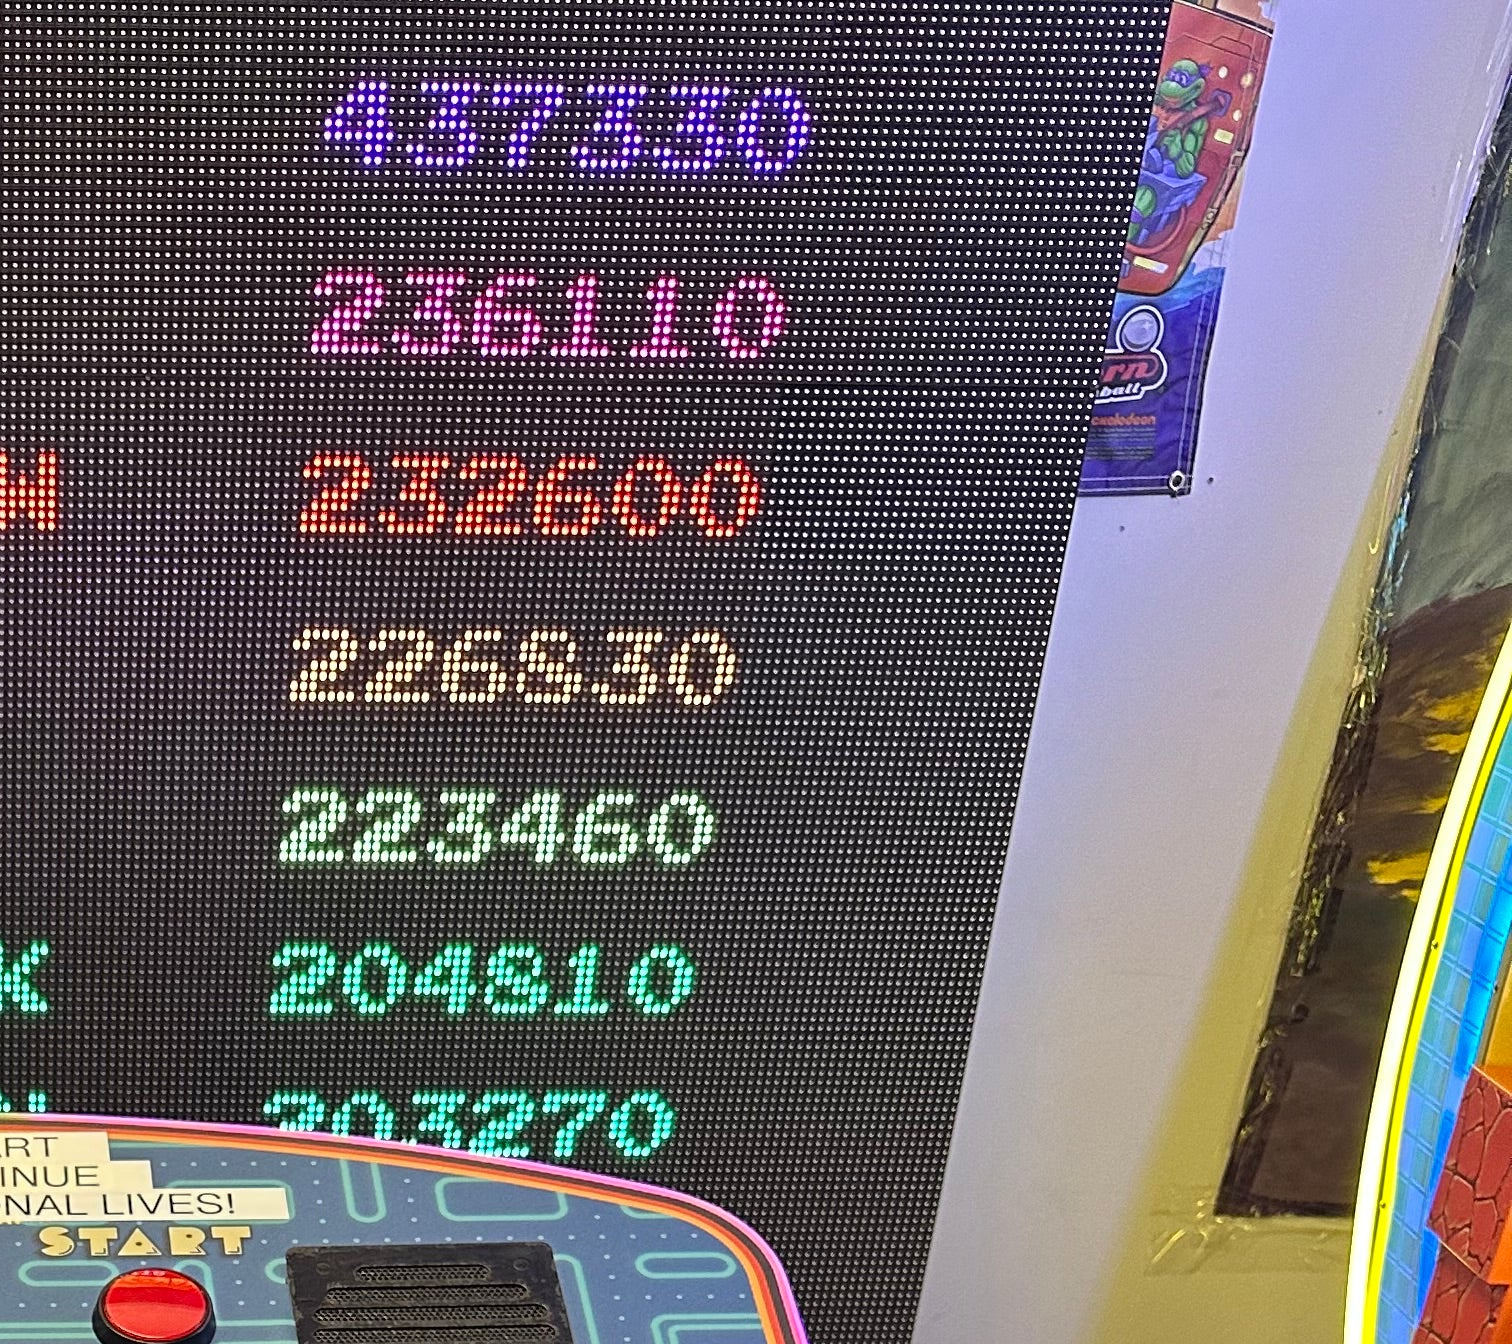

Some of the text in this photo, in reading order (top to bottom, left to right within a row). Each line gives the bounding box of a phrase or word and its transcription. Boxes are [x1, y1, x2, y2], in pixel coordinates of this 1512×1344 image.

[324, 80, 812, 174] 437330
[311, 269, 788, 359] 236110
[299, 453, 762, 537] 232600
[288, 626, 737, 706] 226830
[279, 788, 717, 865] 223460
[269, 942, 695, 1014] 204810
[38, 1225, 252, 1257] START
[103, 1193, 236, 1215] LIVES!
